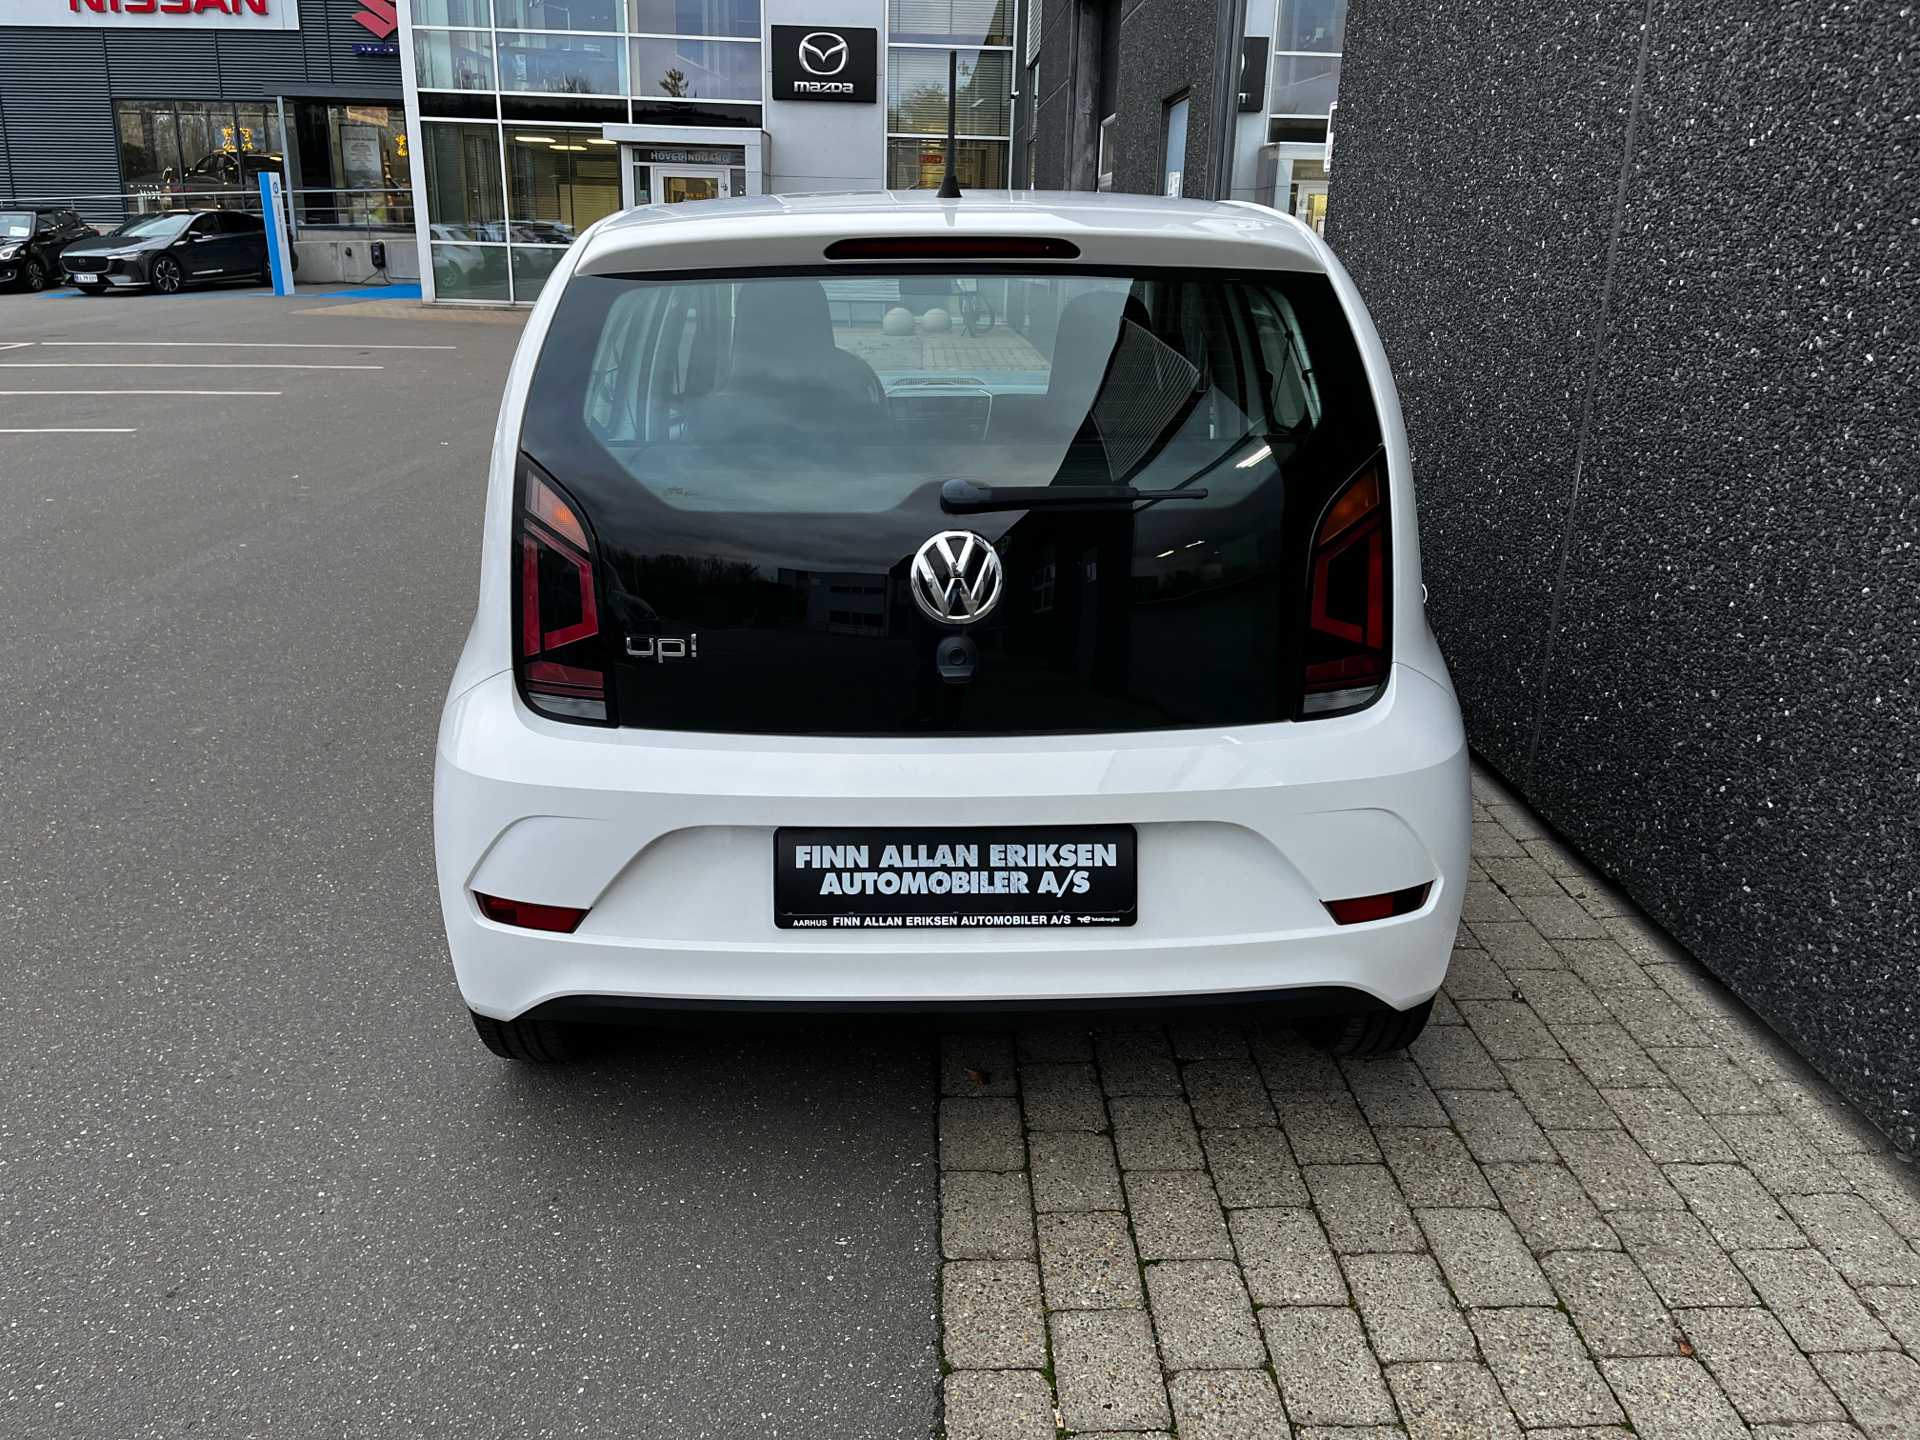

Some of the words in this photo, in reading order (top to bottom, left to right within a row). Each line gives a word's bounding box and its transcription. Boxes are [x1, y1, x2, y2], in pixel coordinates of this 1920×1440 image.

[650, 152, 729, 162] HOVEDINDGANG
[626, 633, 697, 664] up!
[795, 846, 869, 868] FINN
[879, 845, 979, 867] ALLAN
[990, 844, 1116, 866] ERIKSEN
[819, 871, 1029, 895] AUTOMOBILER
[1037, 870, 1090, 897] A/S
[793, 919, 827, 927] AARHUS
[833, 917, 861, 926] FINN
[864, 916, 904, 926] ALLAN
[906, 916, 958, 926] ERIKSEN
[960, 915, 1048, 925] AUTOMOBILER
[1050, 914, 1071, 925] A/S
